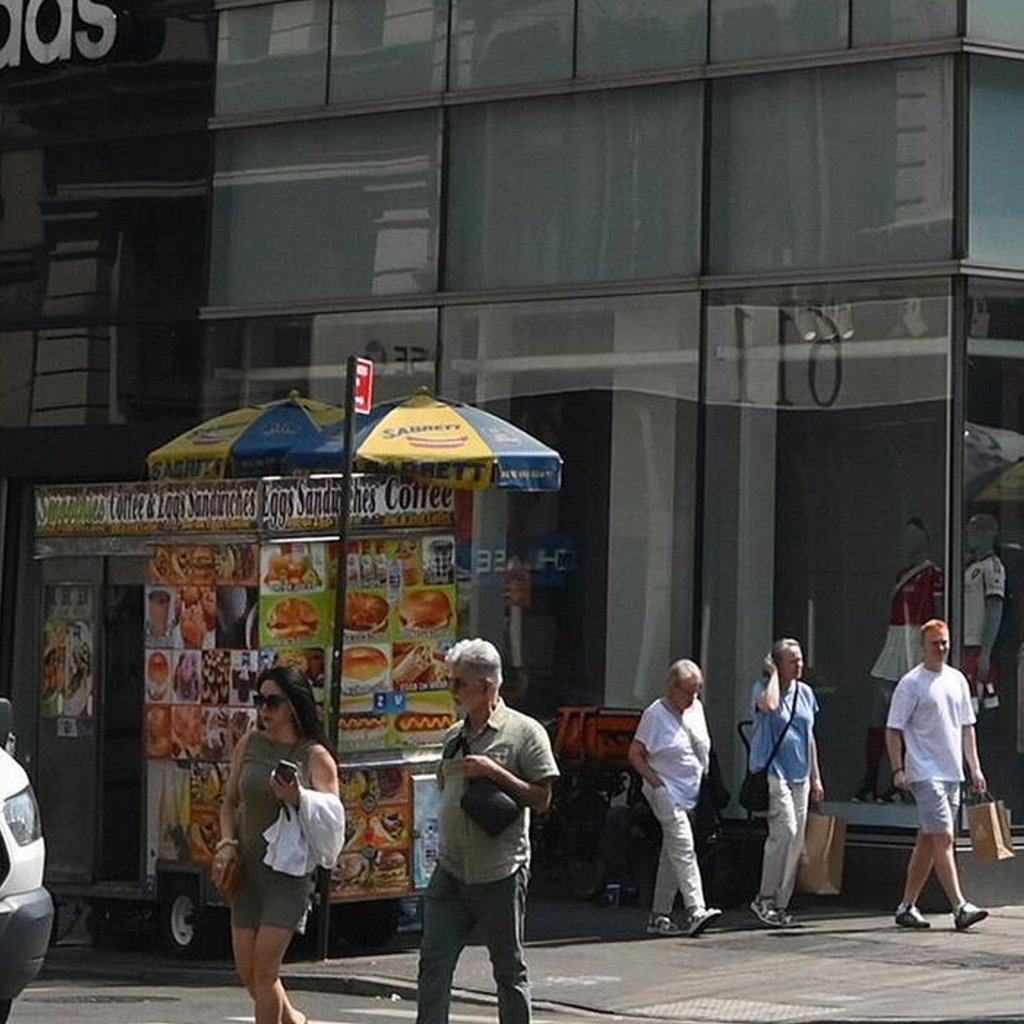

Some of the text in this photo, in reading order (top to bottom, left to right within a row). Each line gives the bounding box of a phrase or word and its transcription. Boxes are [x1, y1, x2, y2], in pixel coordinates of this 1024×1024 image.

[382, 424, 462, 439] SABRETT
[262, 478, 294, 528] Eggs
[384, 477, 453, 511] Coffee
